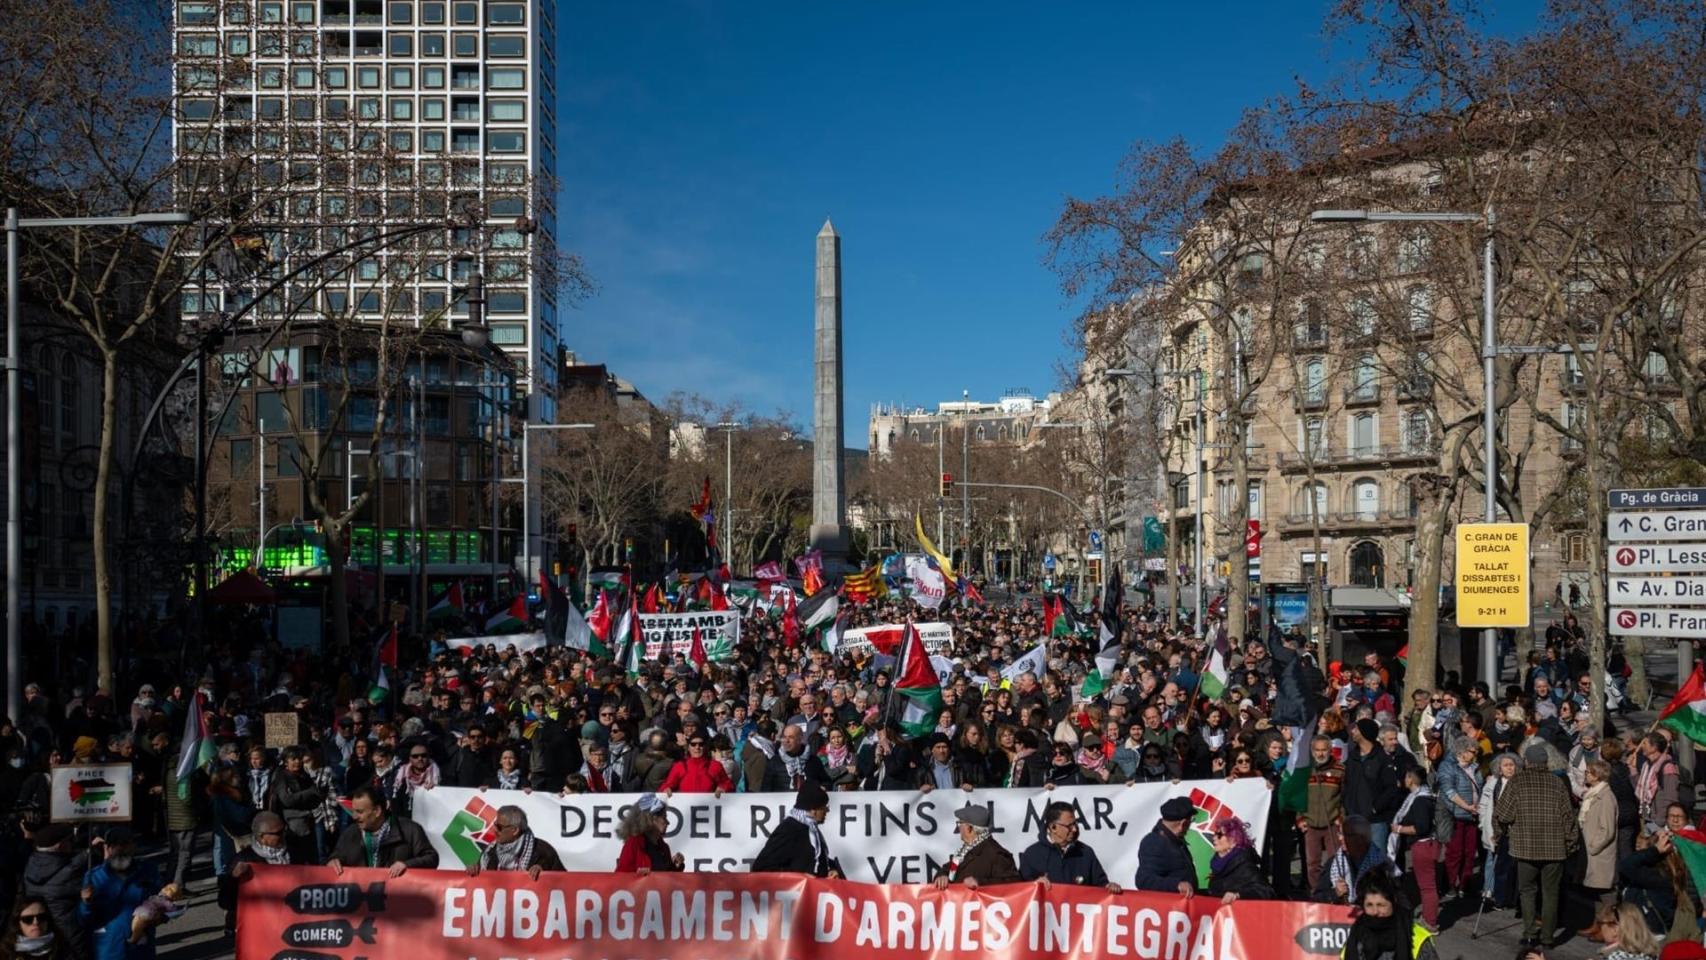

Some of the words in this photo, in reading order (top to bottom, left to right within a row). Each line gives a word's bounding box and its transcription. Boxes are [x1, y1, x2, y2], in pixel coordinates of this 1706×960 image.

[1620, 492, 1639, 505] Pg.
[1642, 492, 1657, 503] de
[1660, 491, 1699, 503] Gràcia
[1639, 516, 1657, 532] C.
[1664, 516, 1706, 532] Gran
[1505, 533, 1518, 541] DE
[1474, 544, 1510, 552] GRÀCIA
[1639, 548, 1661, 564] Pl.
[1462, 574, 1515, 582] DISSABTES
[1463, 586, 1520, 594] DIUMENGES
[1640, 581, 1668, 596] Av.
[1675, 580, 1704, 596] Dia
[1640, 613, 1661, 629] Pl.
[1669, 613, 1706, 630] Fran
[661, 805, 731, 838] DEL
[840, 801, 938, 837] FINS
[300, 888, 349, 910] PROU
[442, 887, 801, 941] EMBARGAMENT
[814, 891, 1011, 951] D'ARMES
[1029, 899, 1236, 960] INTEGRAL
[293, 928, 343, 944] COMERÇ
[1309, 927, 1351, 949] PRO
